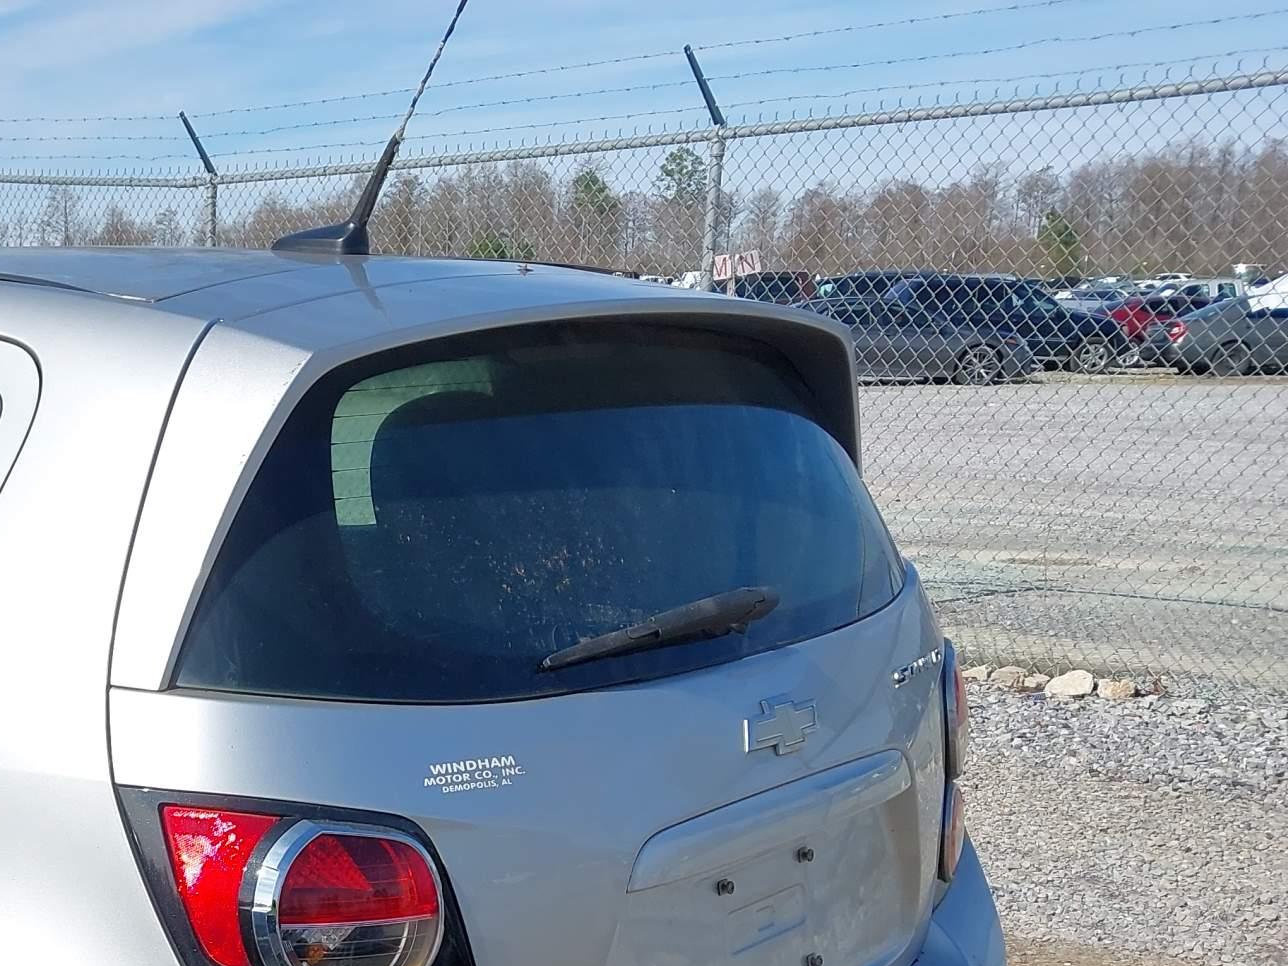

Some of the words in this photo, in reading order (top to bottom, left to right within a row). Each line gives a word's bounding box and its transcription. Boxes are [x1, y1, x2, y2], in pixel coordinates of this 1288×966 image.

[429, 755, 516, 775] WINDHAM
[423, 773, 471, 787] MOTOR
[474, 770, 498, 780] CO.,
[501, 766, 526, 777] INC.
[442, 779, 499, 793] DEMOPOLIS,
[501, 778, 513, 786] AL
